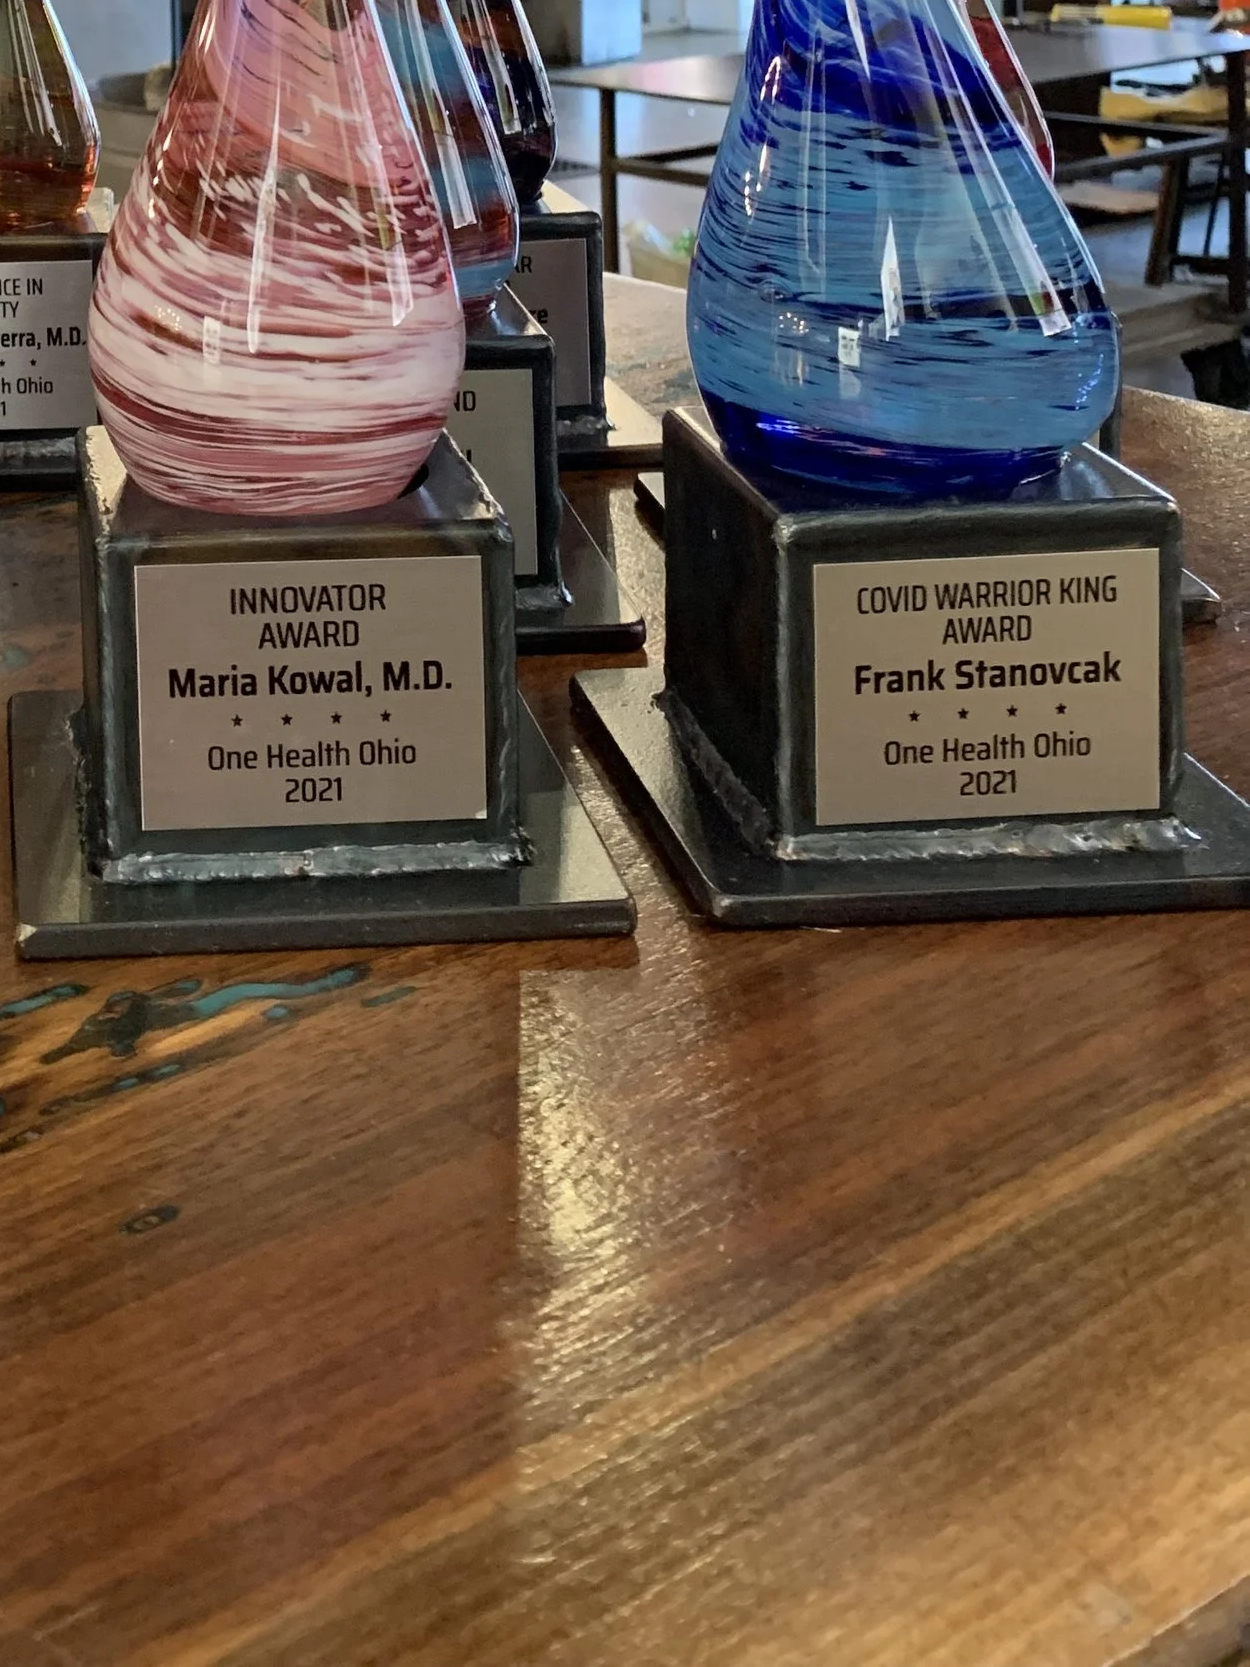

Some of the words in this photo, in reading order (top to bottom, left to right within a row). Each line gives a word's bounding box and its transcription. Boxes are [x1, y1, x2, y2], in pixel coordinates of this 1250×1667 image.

[27, 278, 43, 295] IN
[46, 326, 87, 347] M.D.
[17, 377, 54, 394] Ohio
[230, 583, 387, 615] INNOVATOR
[857, 585, 928, 614] COVID
[934, 579, 1051, 610] WARRIOR
[1059, 575, 1118, 604] KING
[258, 620, 360, 650] AWARD
[942, 615, 1032, 645] AWARD
[168, 665, 258, 699] Maria
[268, 660, 373, 698] Kowal,
[382, 660, 452, 692] M.D.
[854, 659, 946, 695] Frank
[955, 651, 1121, 690] Stanovcak
[207, 745, 258, 771] One
[266, 740, 350, 769] Health
[359, 738, 417, 766] Ohio
[884, 740, 934, 766] One
[942, 734, 1025, 763] Health
[1034, 730, 1092, 758] Ohio
[285, 777, 343, 803] 2021
[959, 769, 1017, 796] 2021
